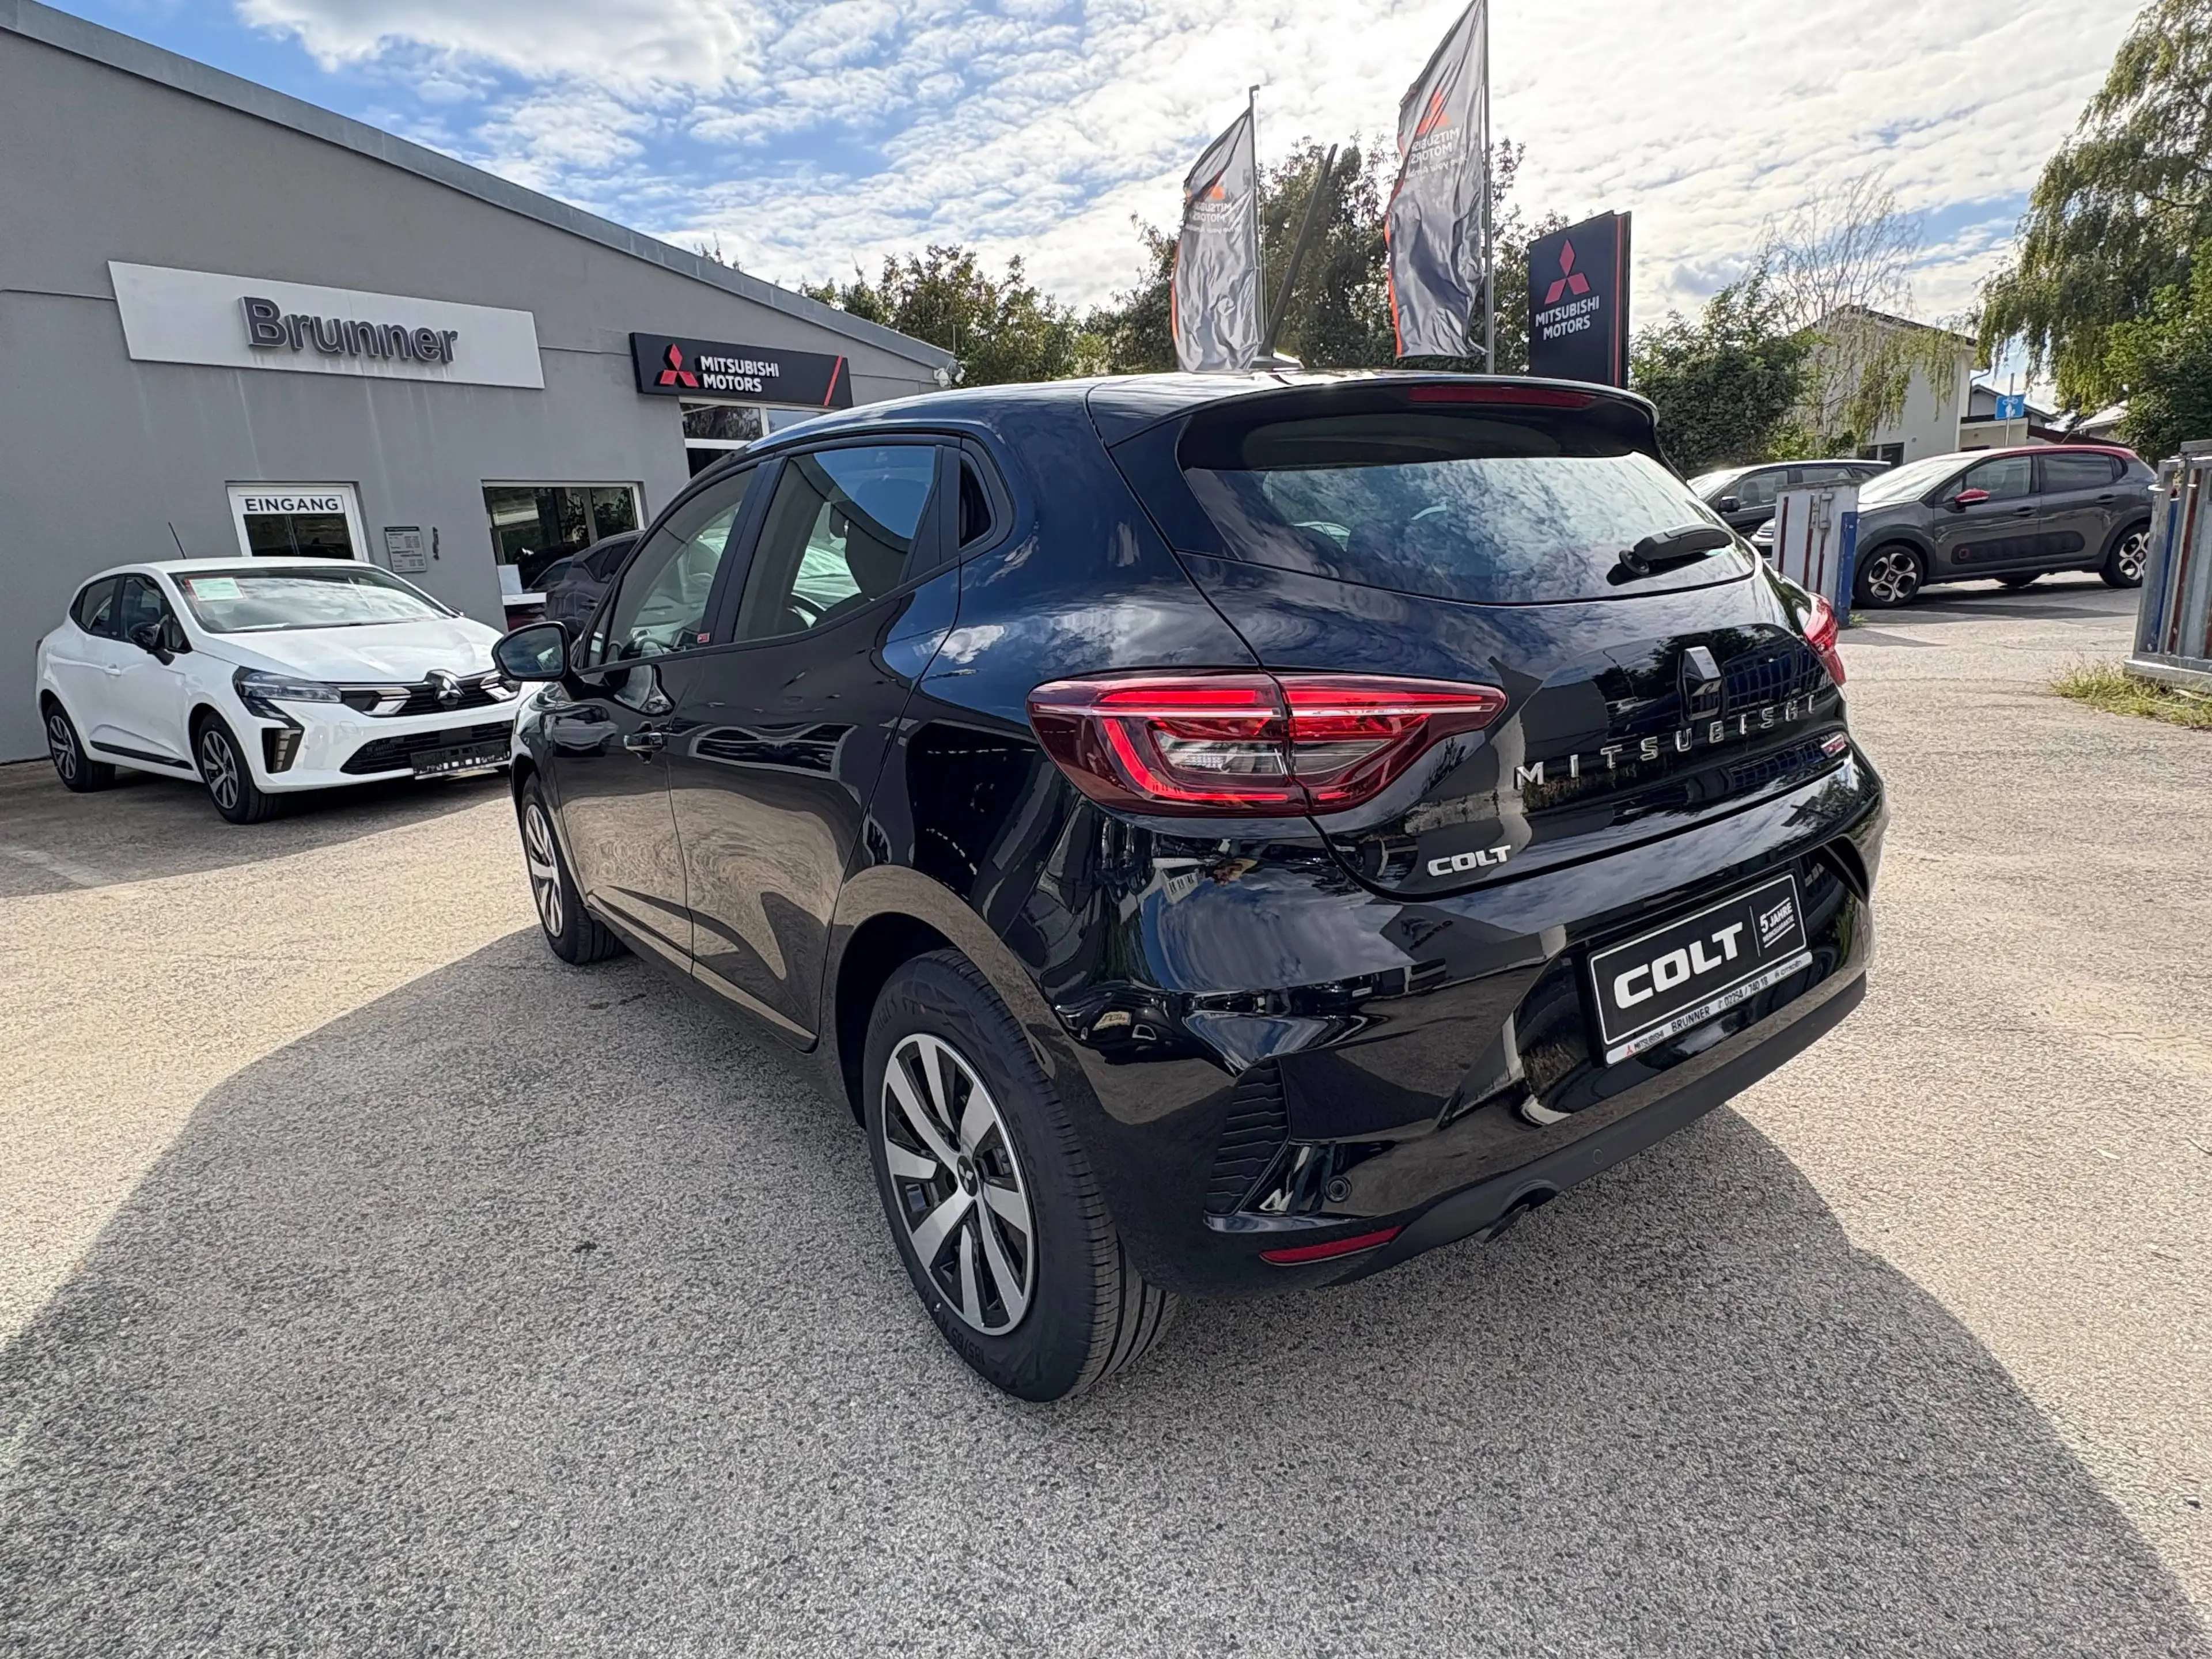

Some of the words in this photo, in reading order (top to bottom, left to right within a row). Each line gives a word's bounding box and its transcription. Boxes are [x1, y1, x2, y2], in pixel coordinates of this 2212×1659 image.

[1535, 295, 1600, 327] MITSUBISHI
[238, 296, 459, 364] Brunner
[1543, 315, 1590, 340] MOTORS
[700, 355, 779, 377] MITSUBISHI
[703, 373, 763, 392] MOTORS
[245, 498, 339, 512] EINGANG
[1514, 695, 1816, 789] MITSUBISHI
[1427, 844, 1511, 877] COLT
[1760, 913, 1769, 933] 5
[1770, 902, 1793, 927] JAHRE
[1613, 922, 1743, 1009] COLT
[1671, 1006, 1710, 1032] BRUNNER
